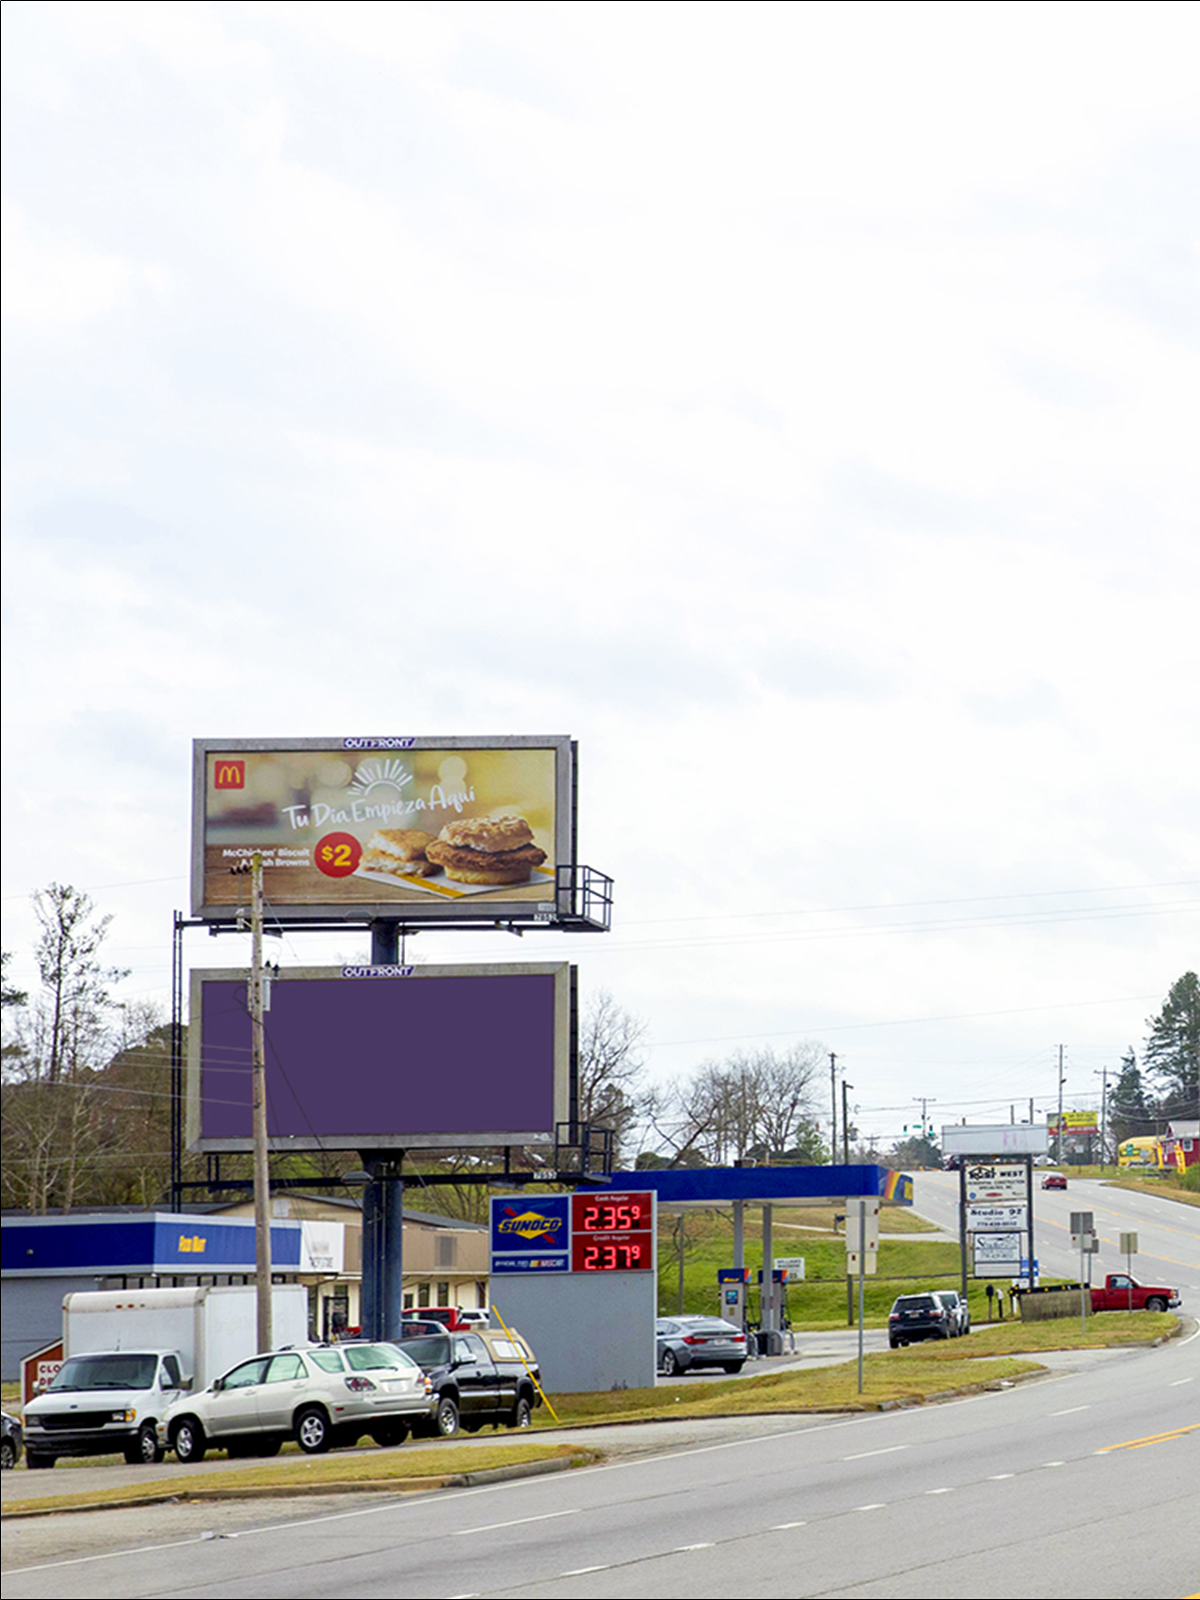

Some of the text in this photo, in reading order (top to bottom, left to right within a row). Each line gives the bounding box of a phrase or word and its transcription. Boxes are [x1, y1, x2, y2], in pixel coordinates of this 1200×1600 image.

[344, 738, 412, 748] OUTFRONT
[282, 804, 309, 829] Tu
[351, 798, 426, 823] Empieza
[278, 848, 311, 857] Biscuit
[321, 844, 351, 867] $2
[275, 859, 311, 867] Browns
[344, 966, 412, 977] OUTFRONT
[584, 1206, 640, 1230] 2.359
[500, 1218, 561, 1232] SUNOCO
[584, 1245, 641, 1270] 2.379
[39, 1365, 61, 1374] CLO
